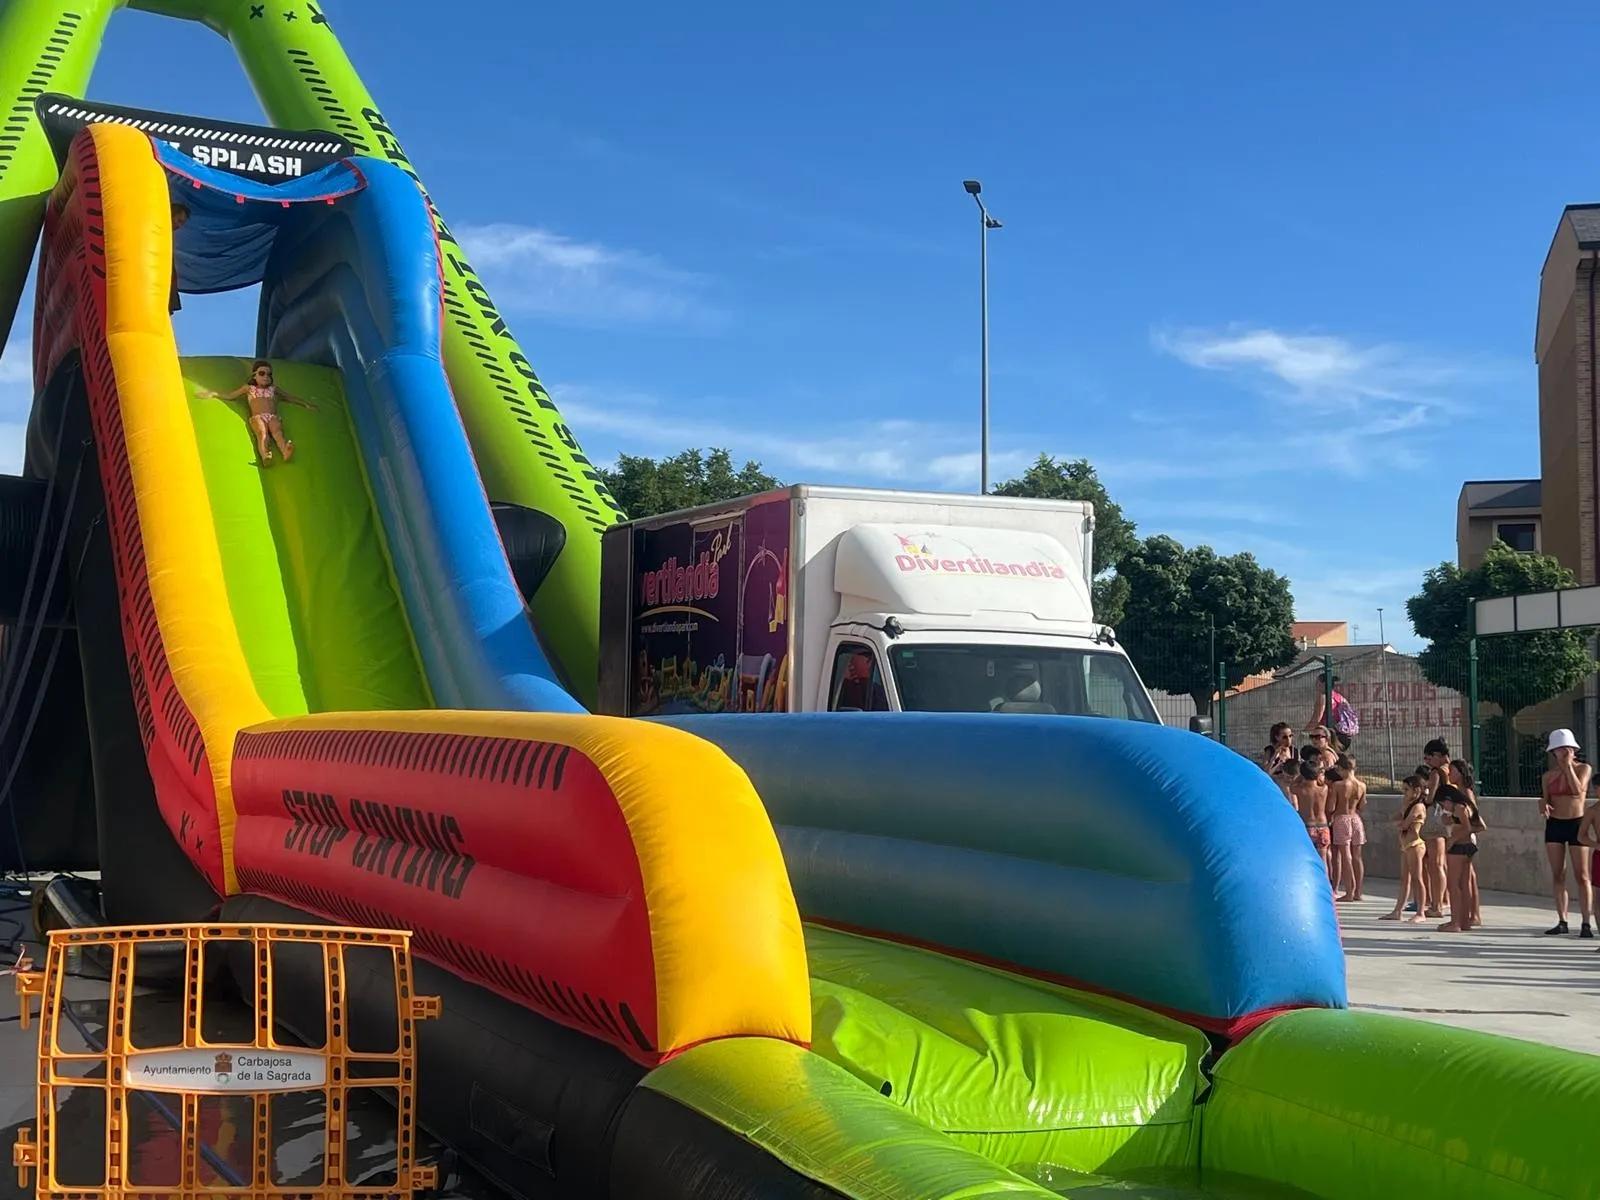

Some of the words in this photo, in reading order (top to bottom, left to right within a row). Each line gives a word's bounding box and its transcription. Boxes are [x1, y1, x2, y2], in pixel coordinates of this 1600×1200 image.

[192, 144, 302, 177] SPLASH
[361, 107, 459, 246] EER
[895, 554, 1066, 579] Divertilandia
[282, 789, 350, 859] STOP
[350, 798, 476, 899] CRYING
[143, 1065, 212, 1075] Ayuntamiento
[237, 1056, 292, 1068] Carbajosa
[237, 1071, 251, 1081] de
[253, 1071, 263, 1081] la
[266, 1071, 312, 1083] Sagrada
